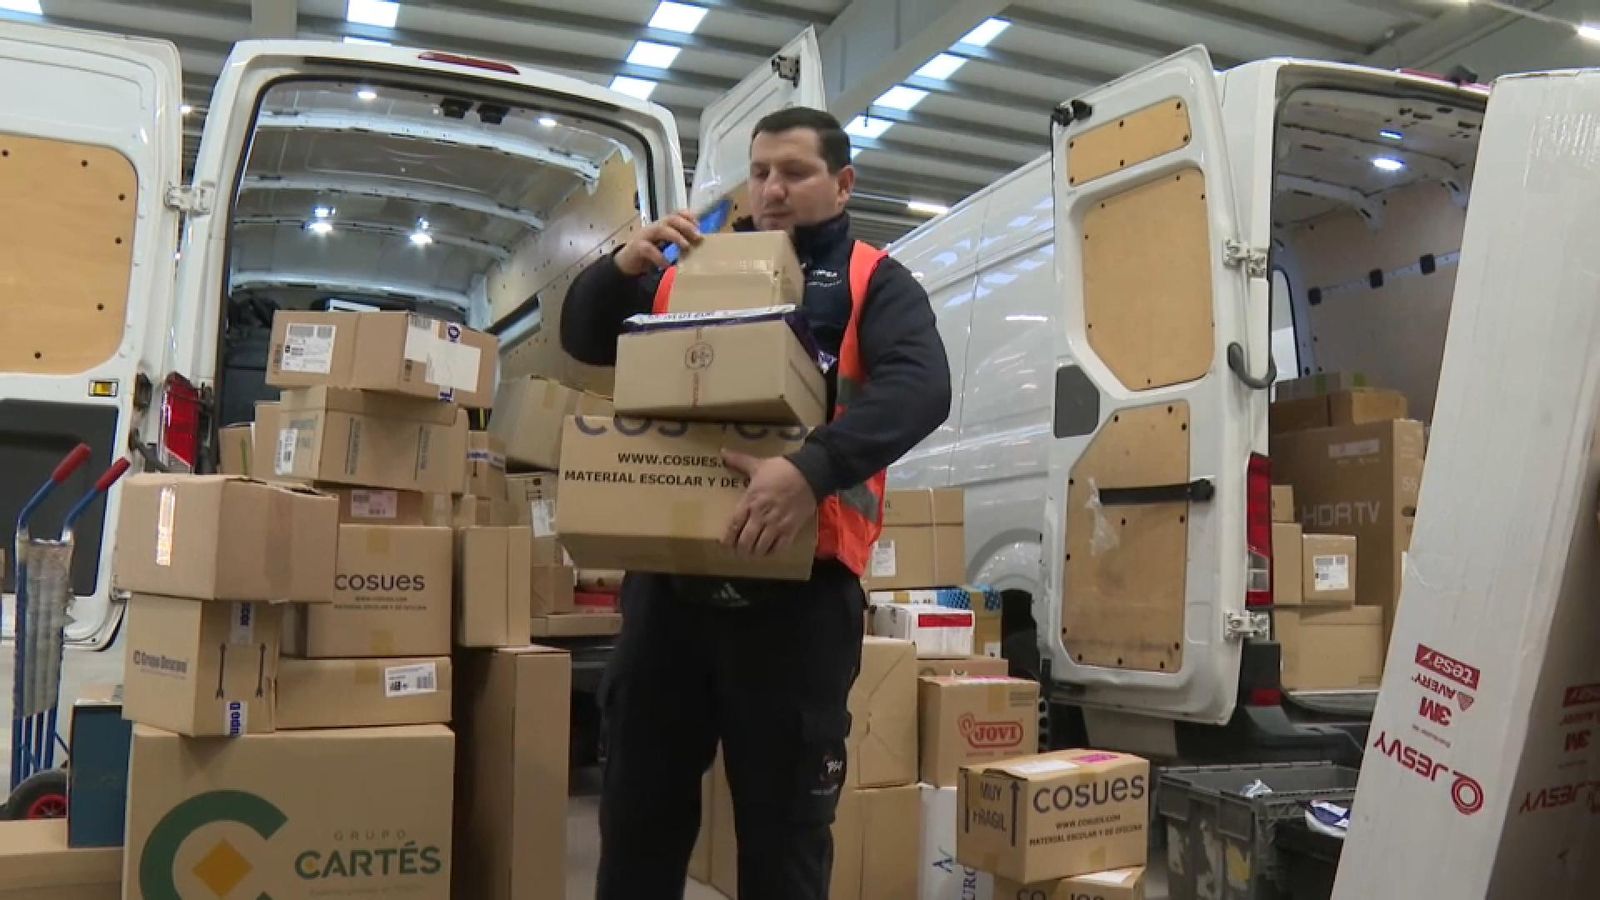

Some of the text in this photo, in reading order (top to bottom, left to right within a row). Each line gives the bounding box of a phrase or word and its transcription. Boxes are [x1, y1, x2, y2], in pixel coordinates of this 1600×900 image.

[564, 470, 636, 484] MATERIAL
[640, 474, 703, 488] ESCOLAR
[707, 477, 716, 488] Y
[720, 477, 738, 488] DE
[1413, 673, 1458, 700] AVERY
[1419, 696, 1452, 726] 3M
[974, 726, 1018, 741] JOVI
[1373, 731, 1449, 781] JESVY
[333, 829, 407, 842] GRUPO
[294, 840, 442, 880] CARTÉS
